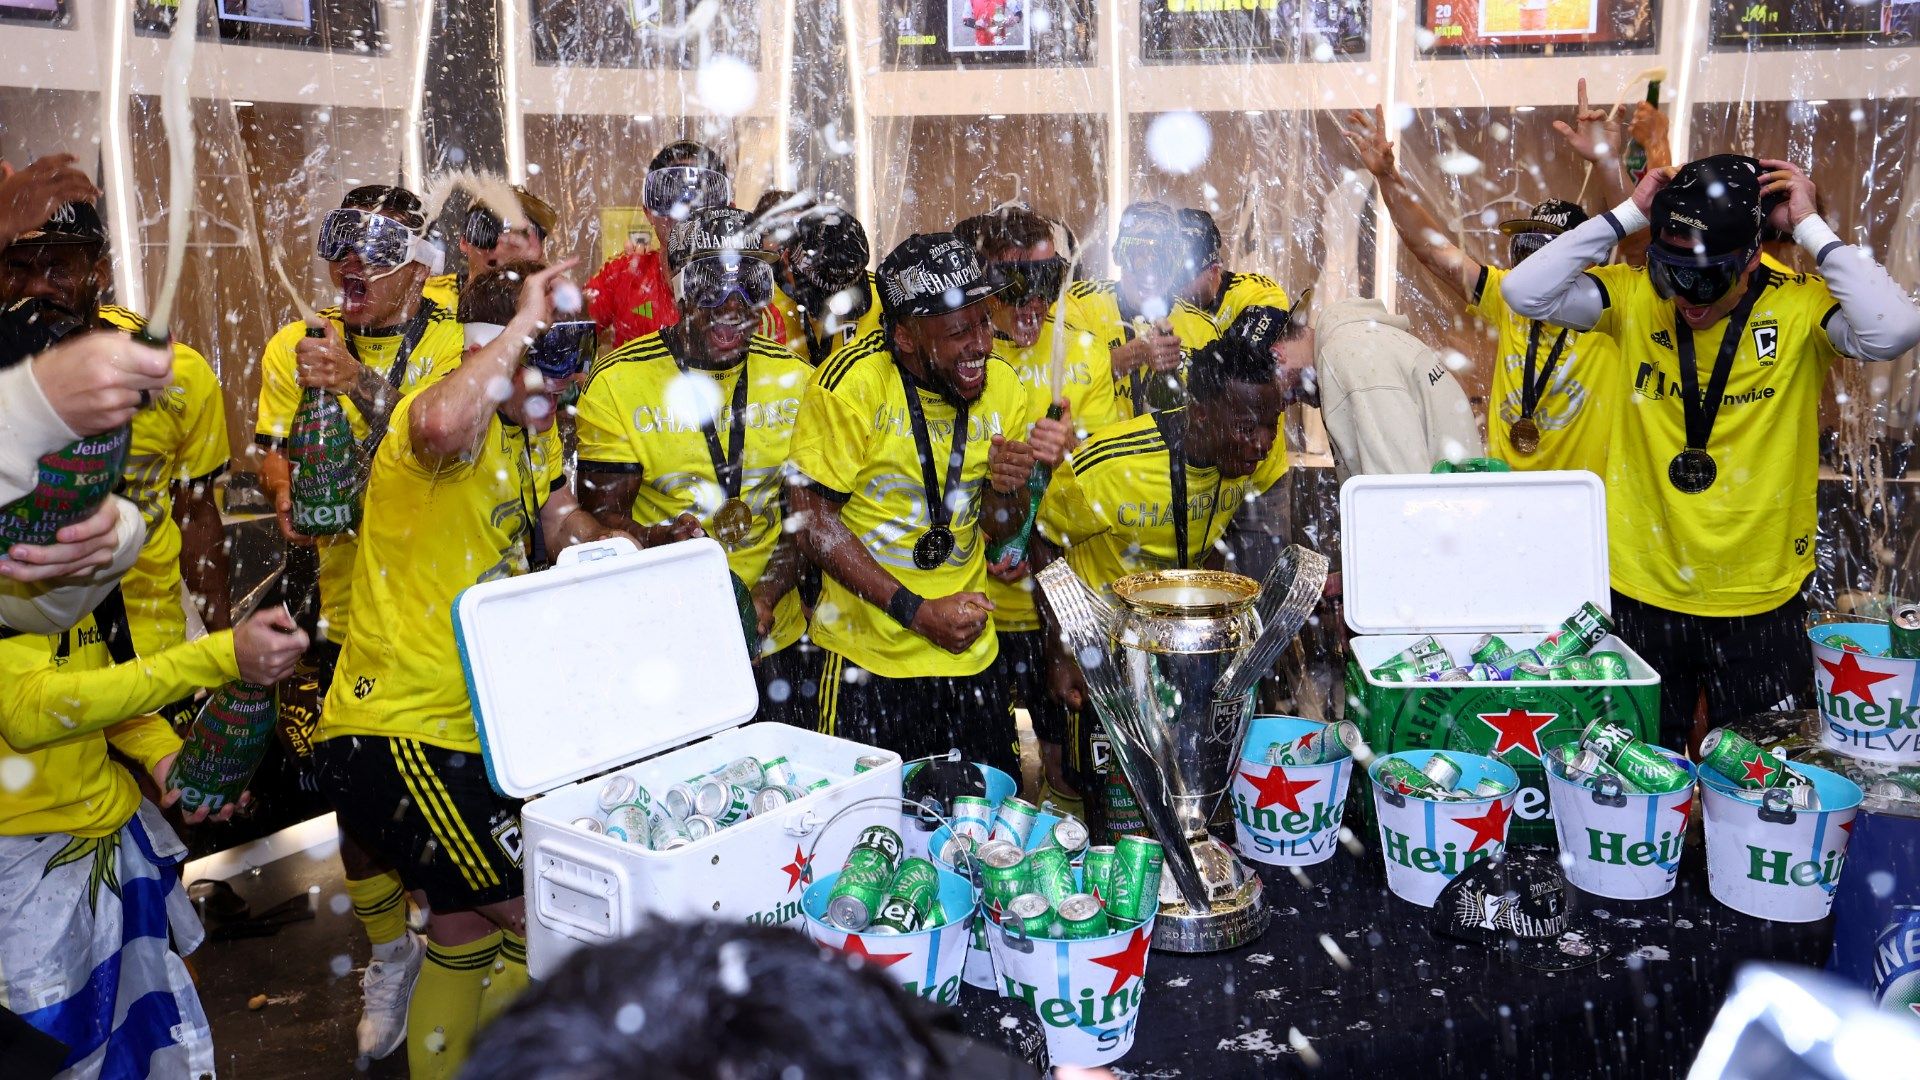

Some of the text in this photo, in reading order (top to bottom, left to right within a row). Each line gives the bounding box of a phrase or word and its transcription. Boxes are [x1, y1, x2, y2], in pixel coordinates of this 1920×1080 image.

[1435, 4, 1452, 18] 20
[695, 228, 762, 250] CHAMPONS
[632, 397, 801, 434] CHAPONS
[228, 700, 271, 713] Jeineken
[1217, 705, 1238, 716] MLS
[1817, 680, 1920, 730] inek
[225, 724, 250, 737] Ken
[1230, 793, 1346, 835] ineke
[1165, 930, 1196, 940] 2023
[1199, 930, 1223, 939] MLS
